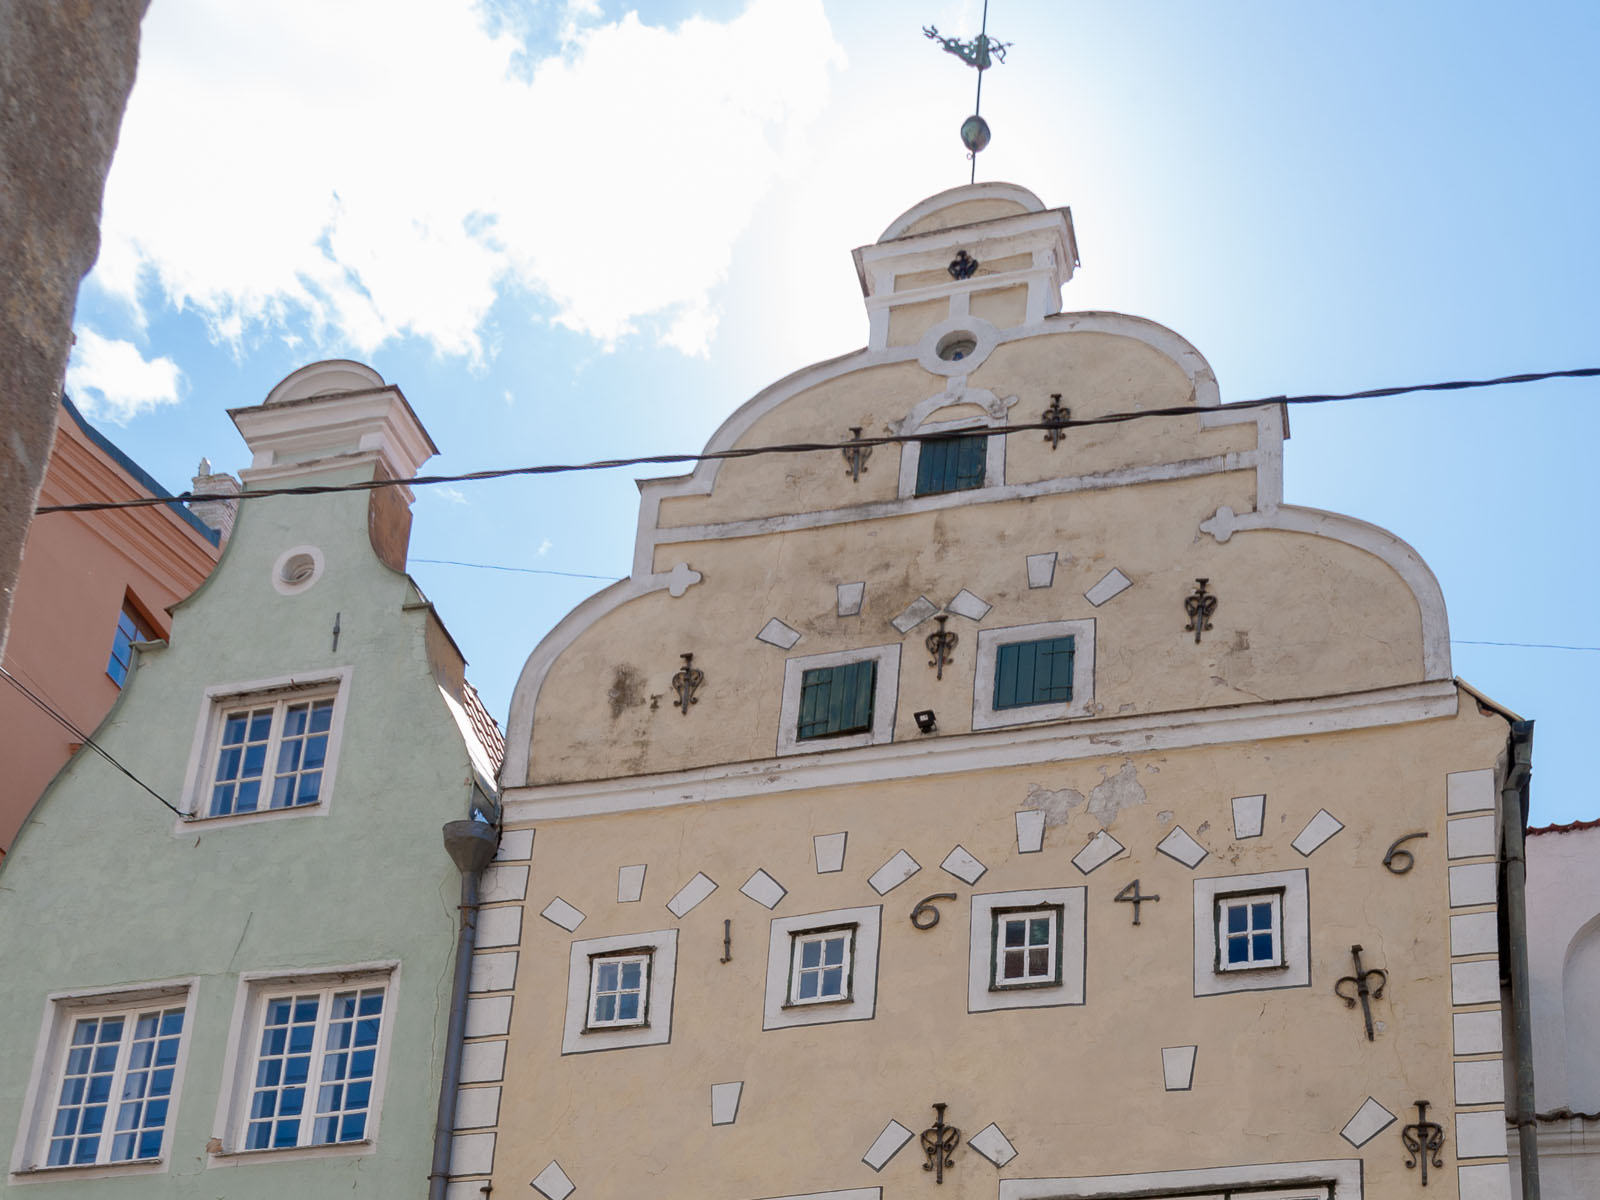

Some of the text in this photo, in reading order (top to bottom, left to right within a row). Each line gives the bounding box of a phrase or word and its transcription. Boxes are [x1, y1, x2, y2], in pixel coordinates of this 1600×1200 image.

[909, 892, 958, 931] 6
[1113, 878, 1160, 927] 4
[1382, 832, 1429, 875] 6
